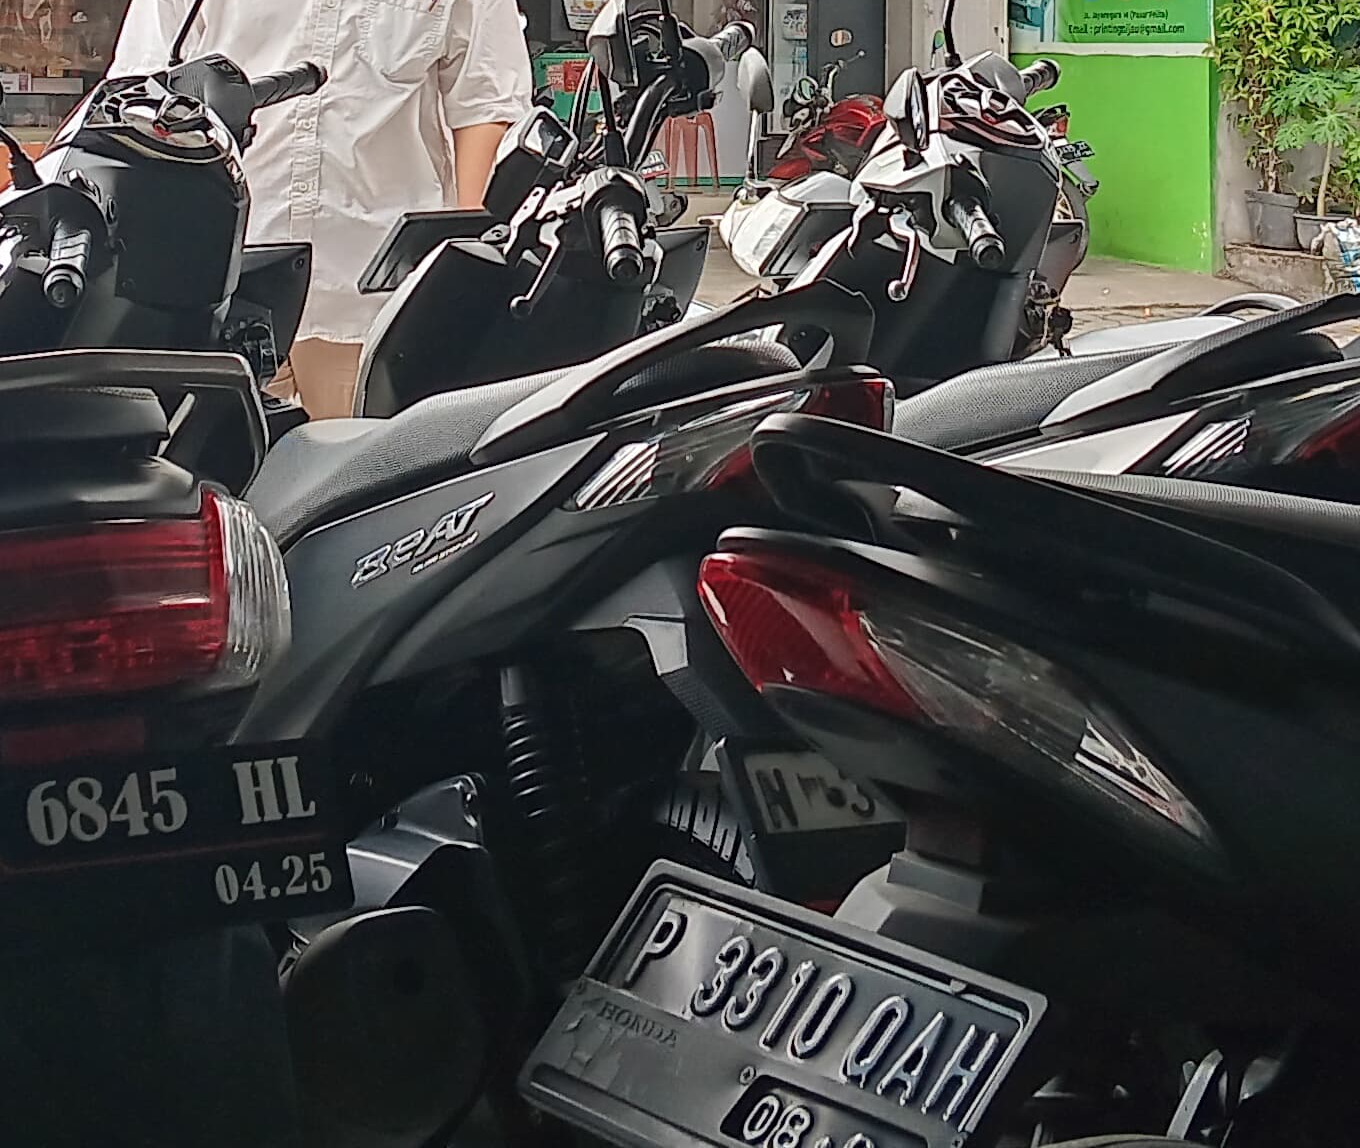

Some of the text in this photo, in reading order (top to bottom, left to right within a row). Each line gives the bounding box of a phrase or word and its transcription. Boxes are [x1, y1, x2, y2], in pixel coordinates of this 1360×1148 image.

[26, 766, 188, 846] 6845
[233, 756, 317, 825] HL
[215, 852, 332, 905] 04.25
[624, 908, 688, 984] P
[690, 935, 856, 1062] 3310
[595, 1000, 679, 1047] HONDA
